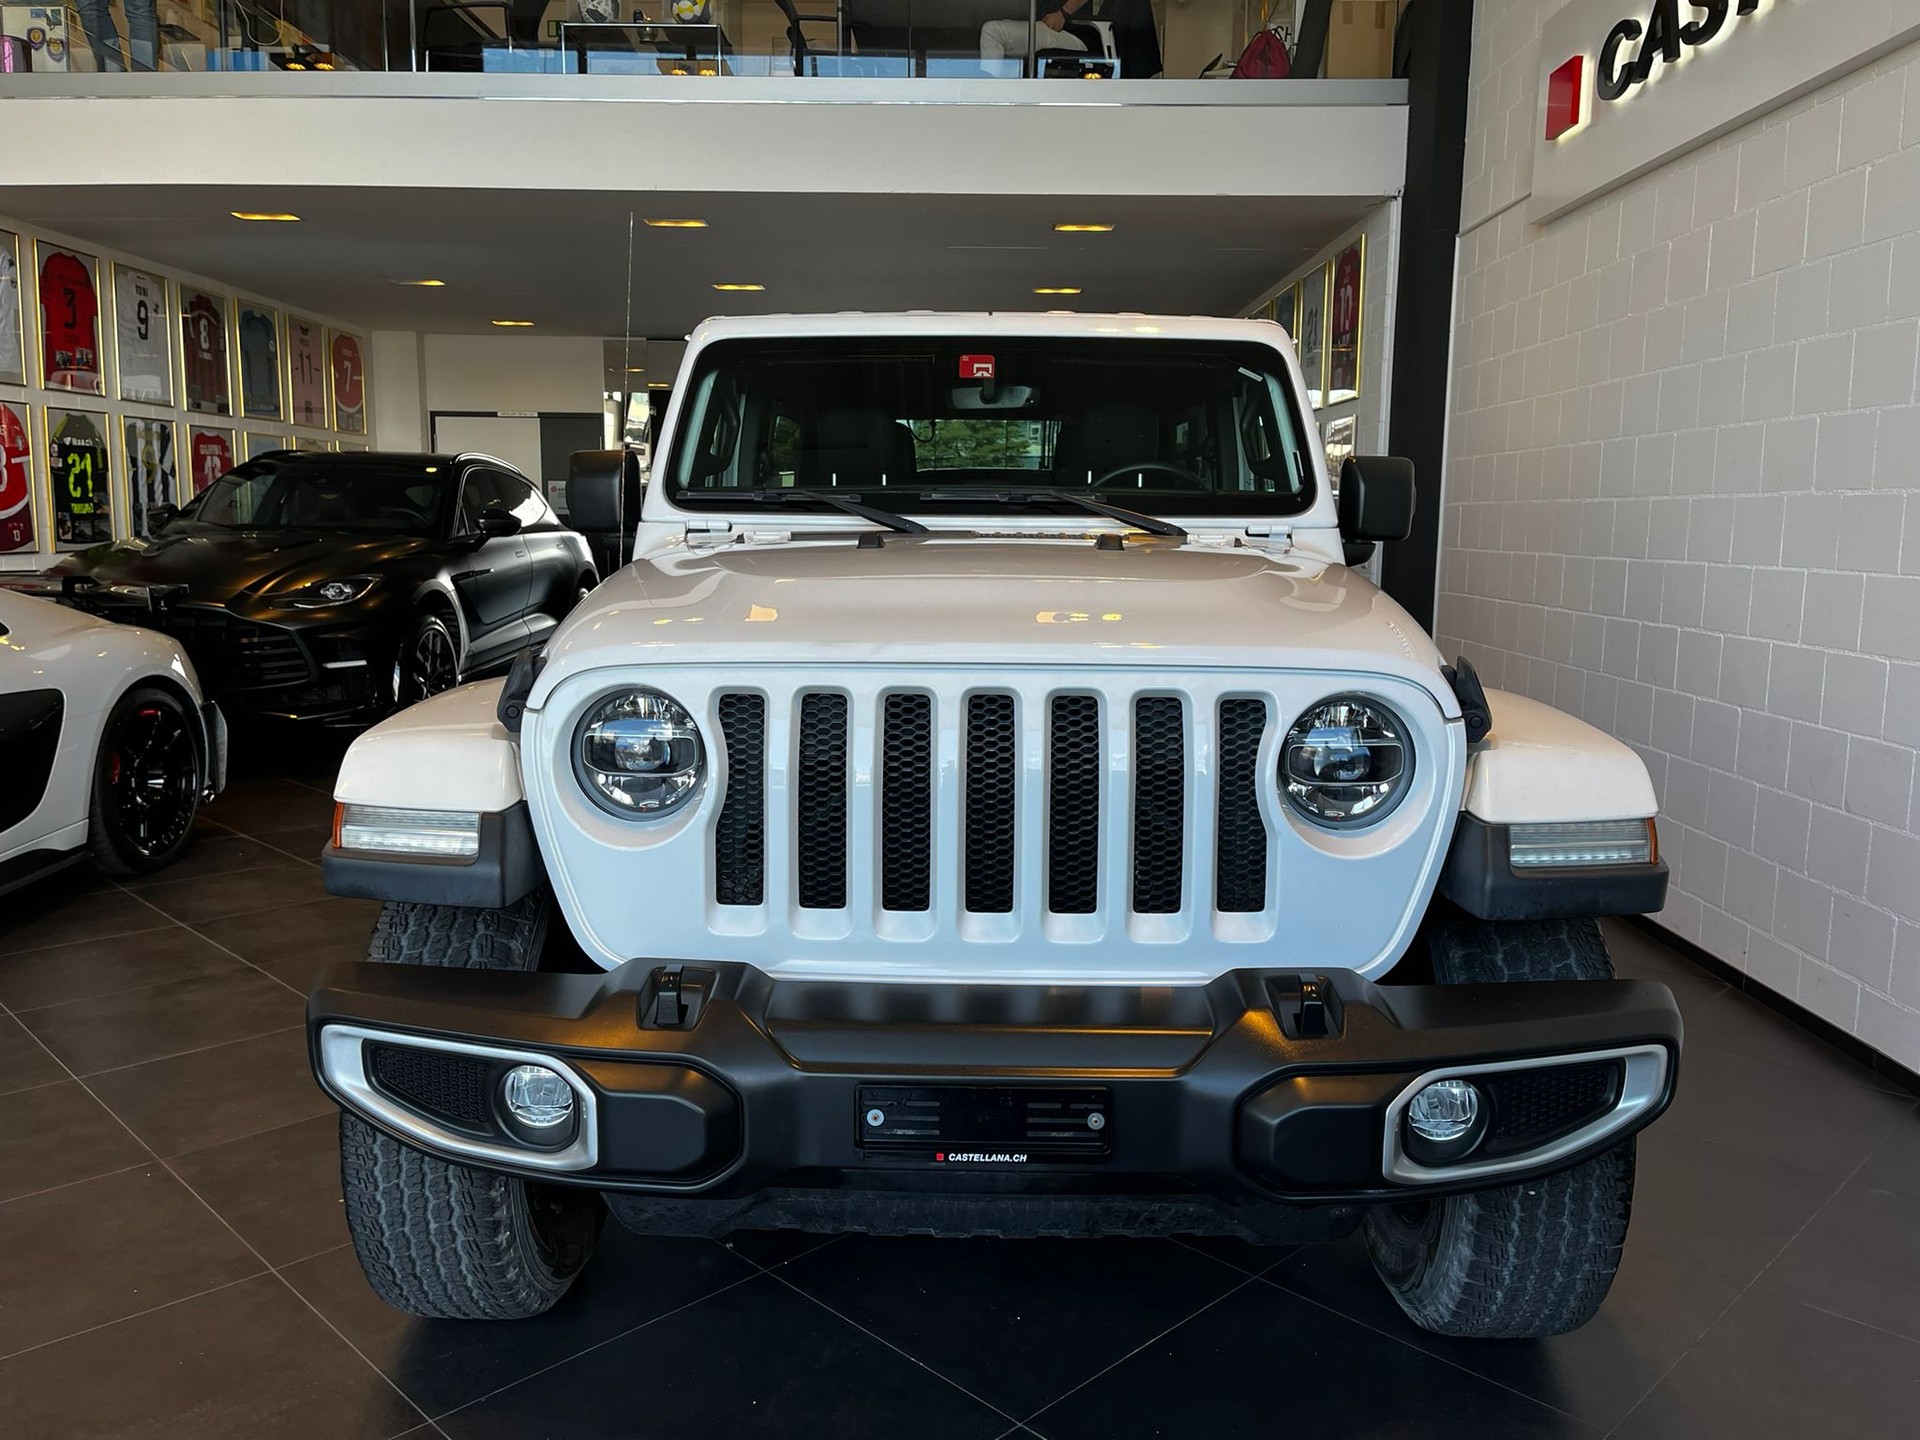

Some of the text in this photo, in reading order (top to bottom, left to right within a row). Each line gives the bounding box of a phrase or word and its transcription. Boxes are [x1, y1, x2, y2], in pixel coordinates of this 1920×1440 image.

[1597, 0, 1758, 100] CAS
[63, 287, 78, 330] 3
[137, 300, 148, 340] 9
[200, 318, 210, 350] 8
[67, 453, 93, 498] 21
[948, 1153, 1028, 1163] CASTELLANA.CH
